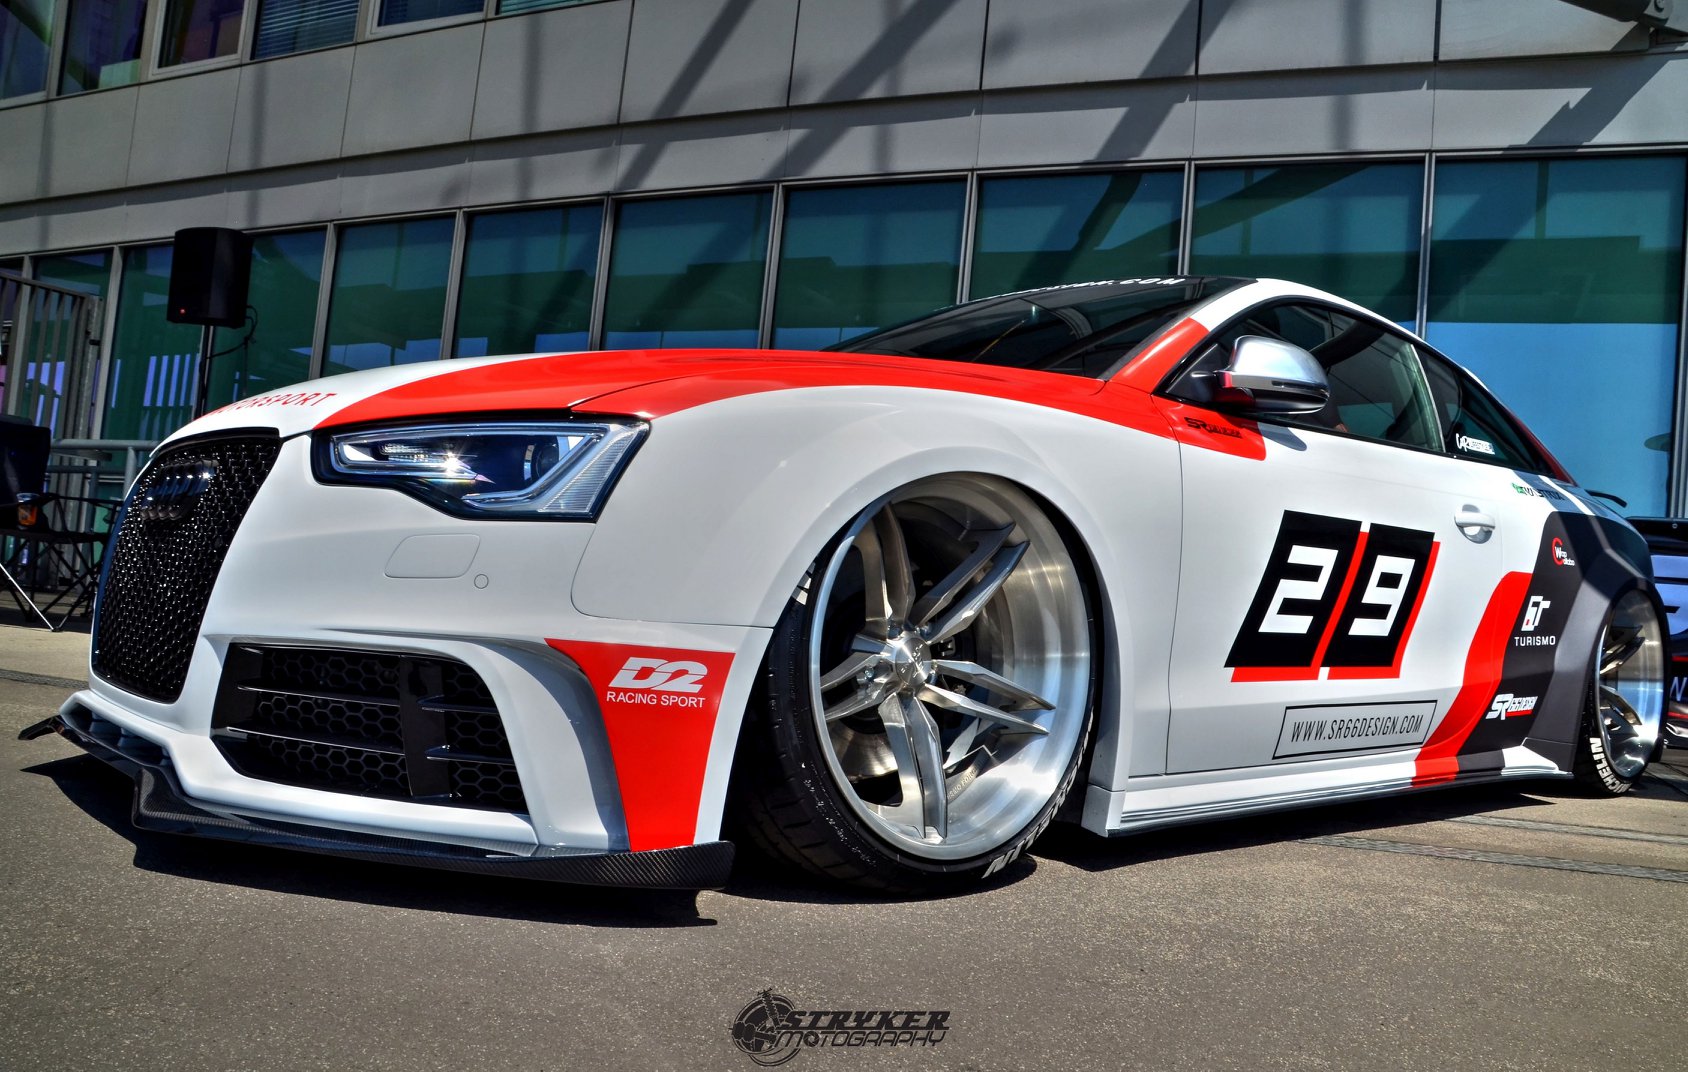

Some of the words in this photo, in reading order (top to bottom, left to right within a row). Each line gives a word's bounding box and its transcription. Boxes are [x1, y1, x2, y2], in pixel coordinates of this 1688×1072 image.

[1258, 544, 1416, 637] 29
[1514, 635, 1556, 647] TURISMO
[608, 656, 708, 693] D2
[606, 691, 657, 705] RACING
[660, 694, 706, 708] SPORT
[1290, 714, 1424, 743] WWW.SR66DESIGN.COM
[1589, 737, 1633, 794] MICHELIN
